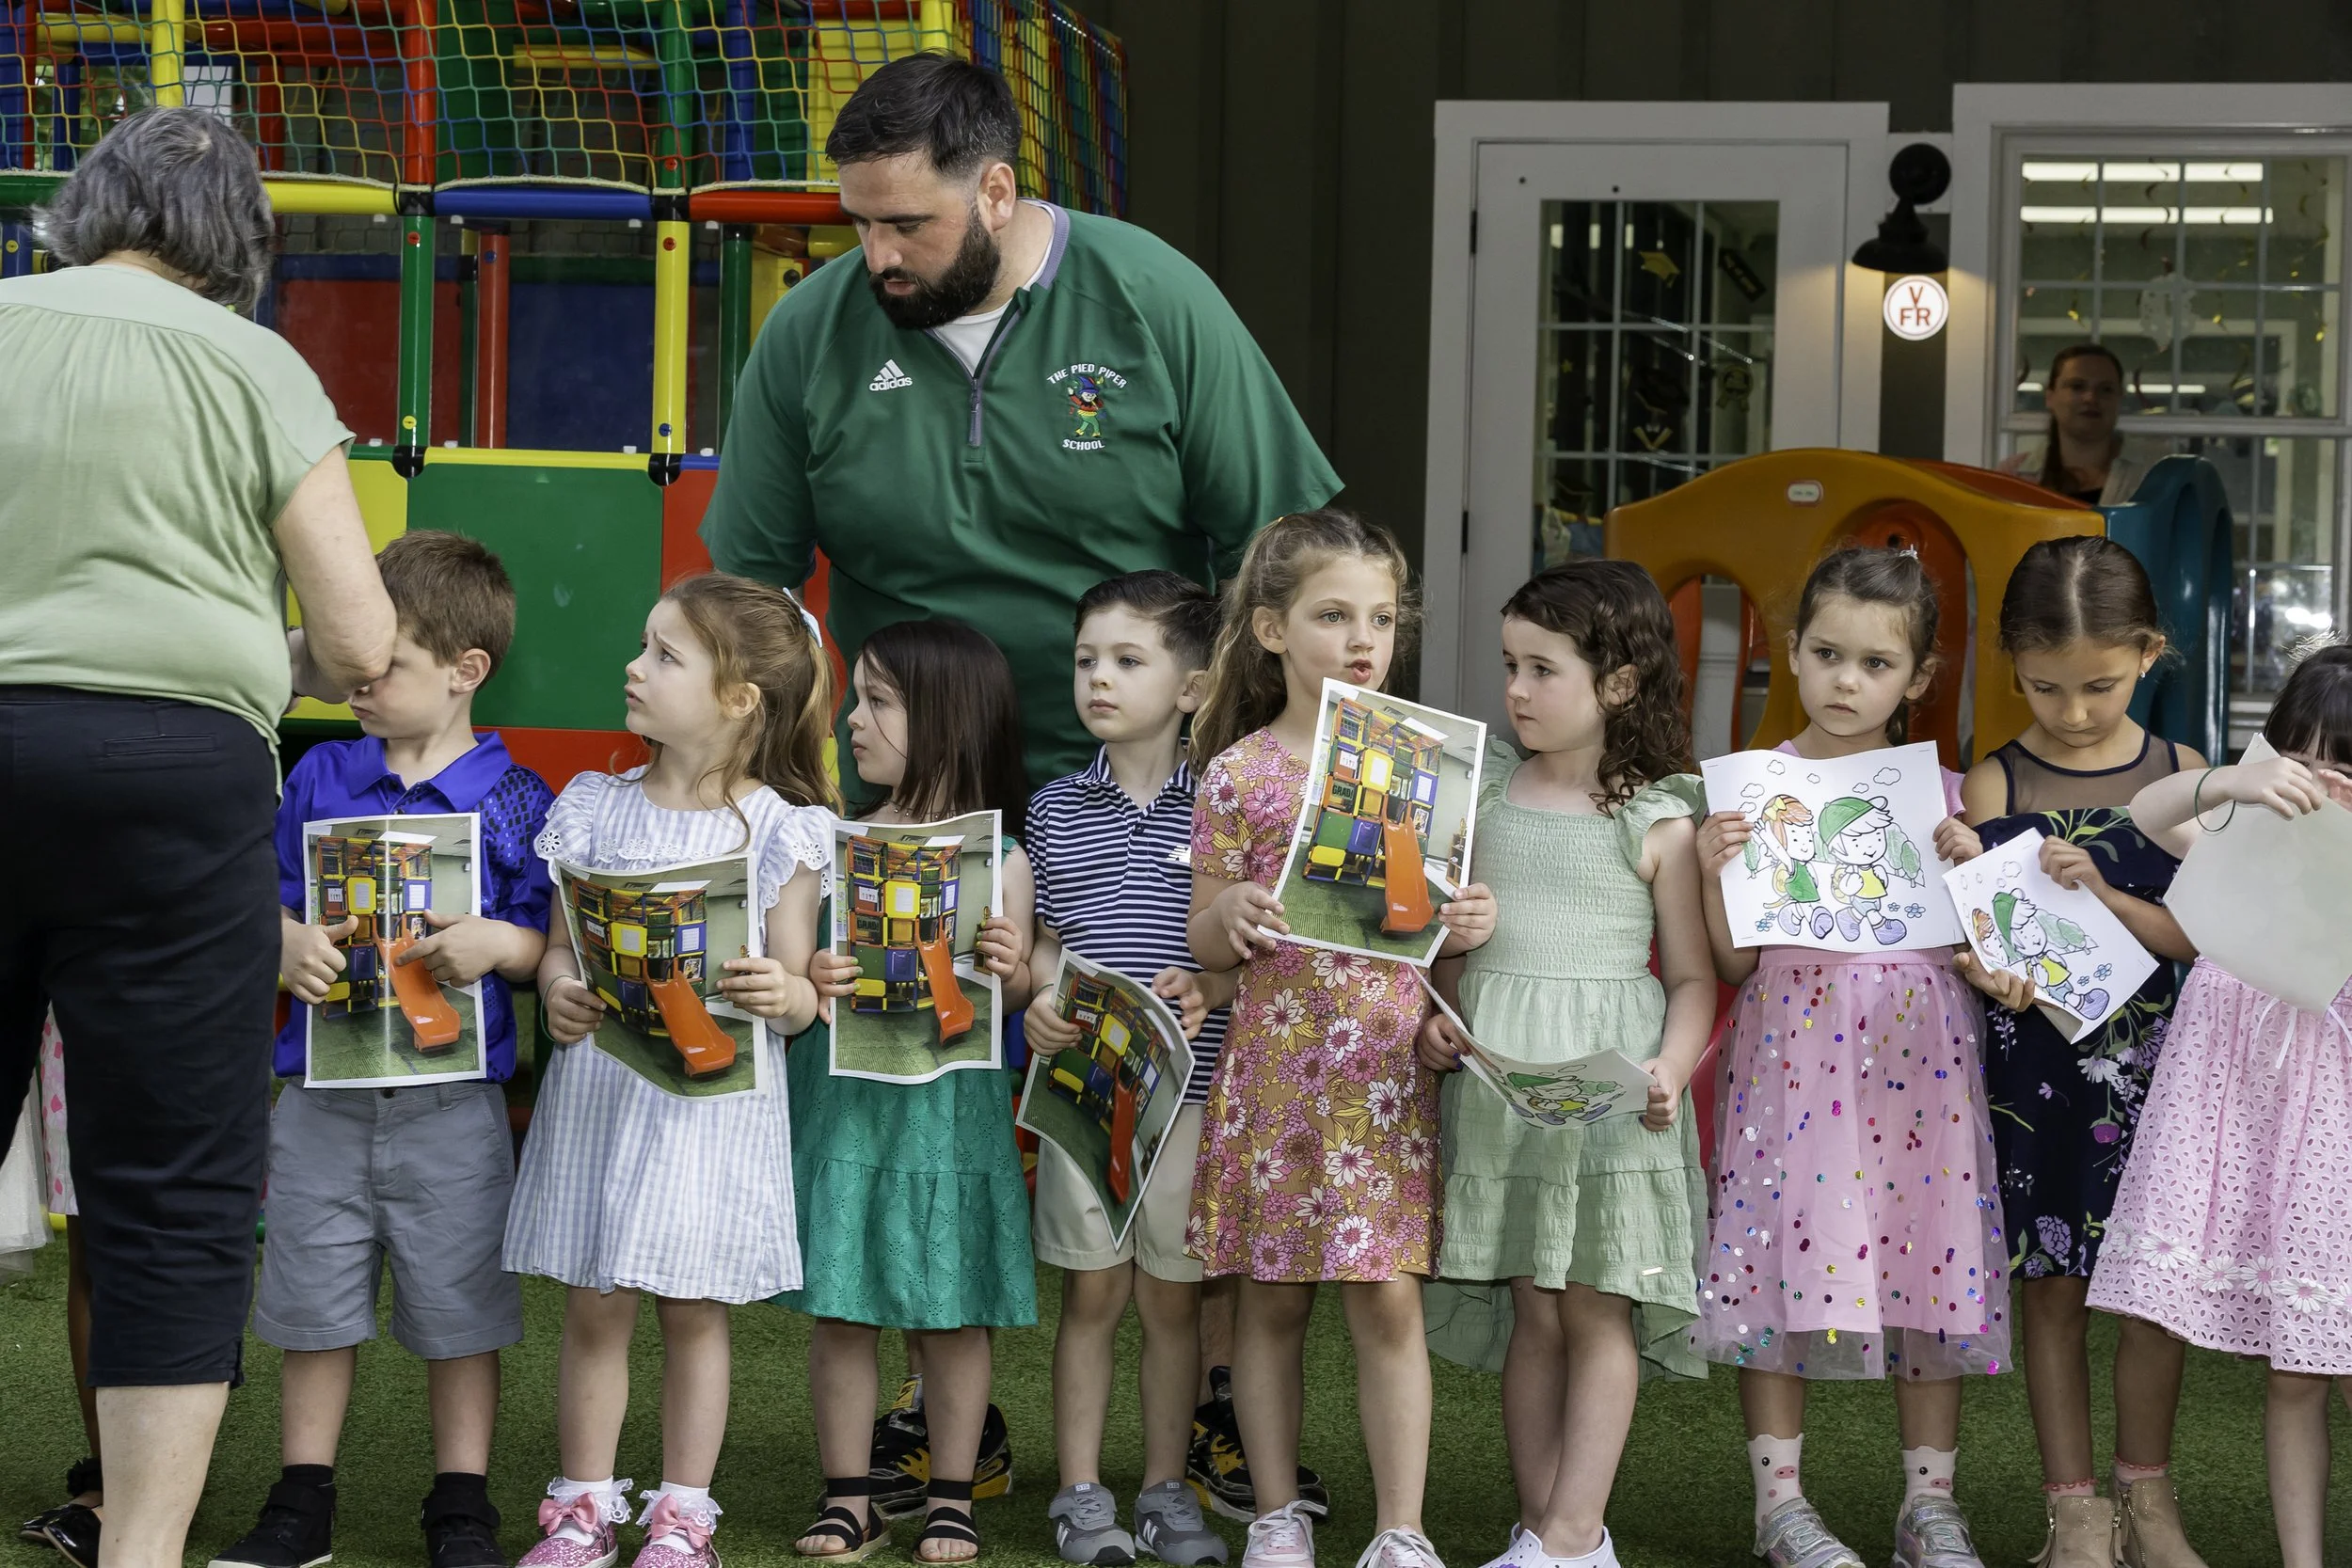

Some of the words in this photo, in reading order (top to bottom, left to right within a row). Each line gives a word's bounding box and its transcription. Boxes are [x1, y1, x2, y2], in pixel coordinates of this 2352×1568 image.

[1899, 307, 1931, 326] FR
[868, 376, 914, 391] adidas
[1046, 368, 1069, 385] THE
[1071, 363, 1095, 374] PIED
[1098, 366, 1128, 388] PIPER
[1062, 438, 1105, 451] SCHOOL
